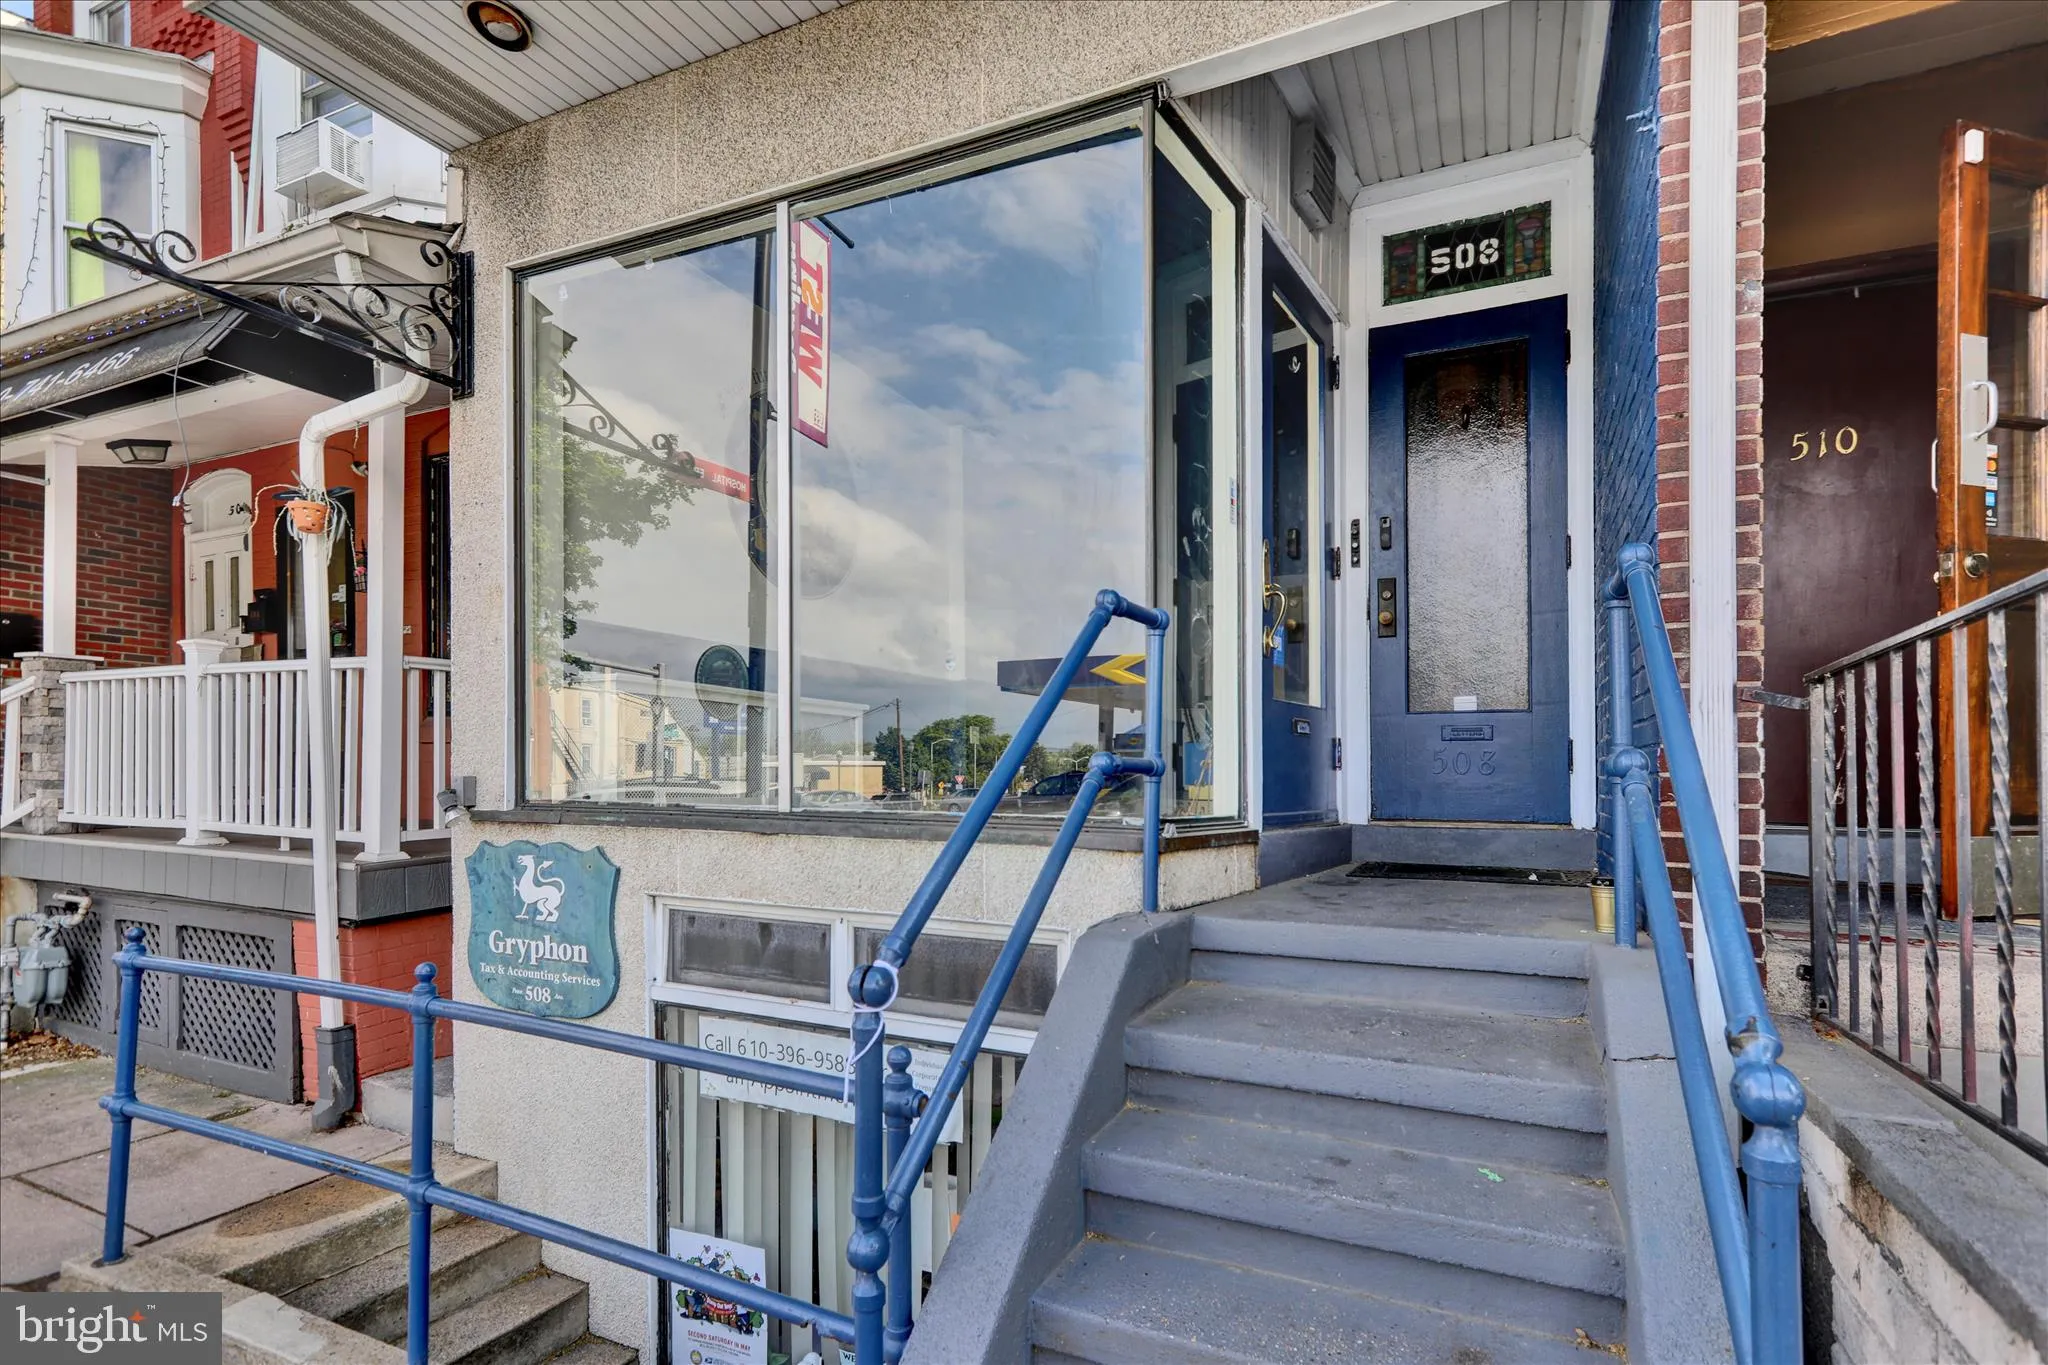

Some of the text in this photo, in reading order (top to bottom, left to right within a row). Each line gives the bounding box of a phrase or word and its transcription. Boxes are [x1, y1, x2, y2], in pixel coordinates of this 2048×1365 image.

[1430, 238, 1500, 275] 508
[1790, 425, 1859, 461] 510
[488, 929, 589, 965] Gryphon
[480, 962, 601, 988] Tax & Accounting Services
[525, 985, 551, 1003] 508
[704, 1033, 731, 1053] Call
